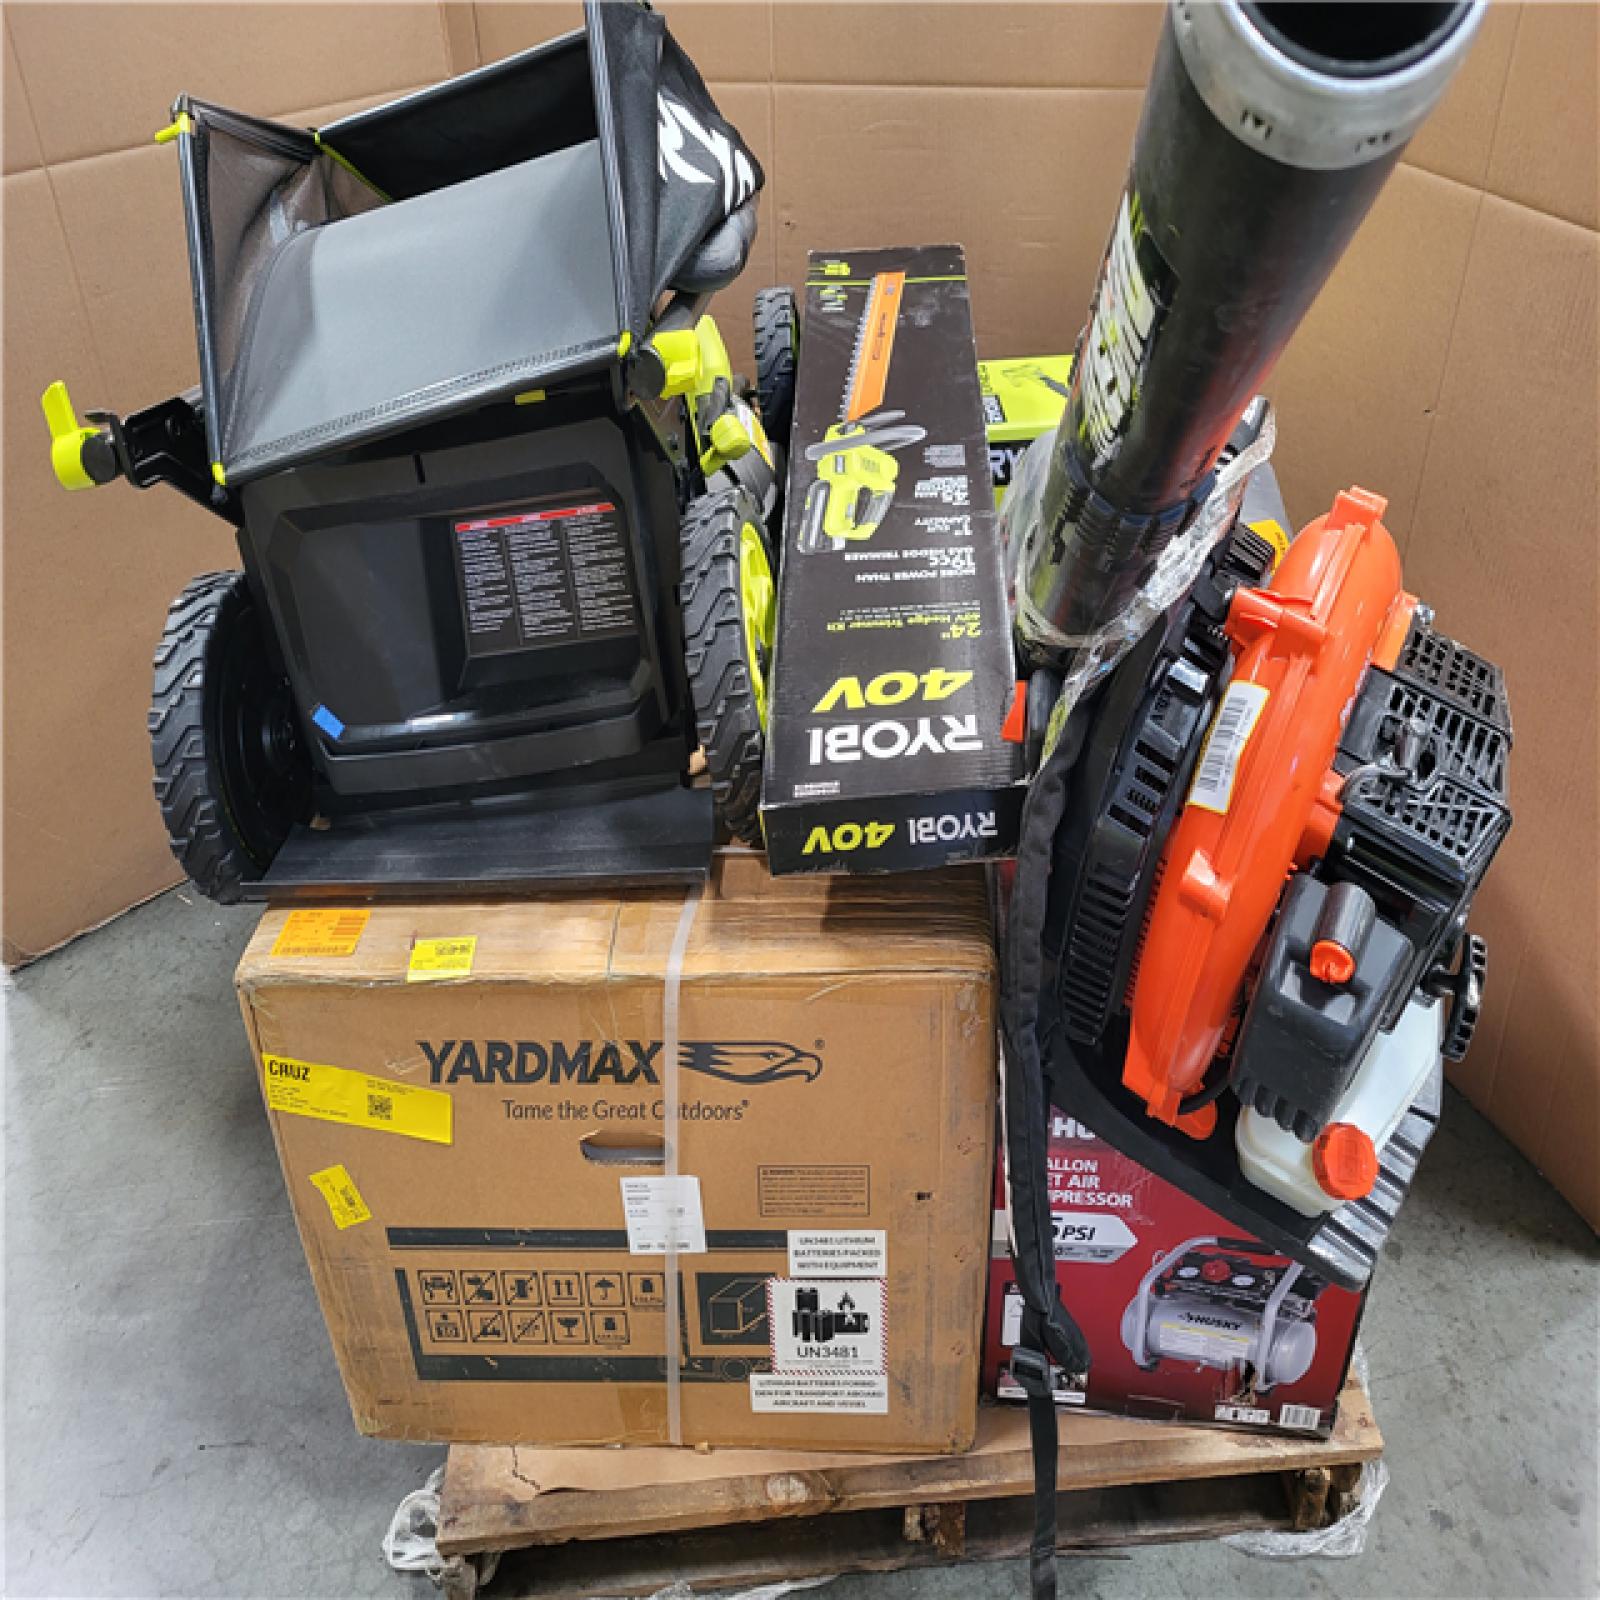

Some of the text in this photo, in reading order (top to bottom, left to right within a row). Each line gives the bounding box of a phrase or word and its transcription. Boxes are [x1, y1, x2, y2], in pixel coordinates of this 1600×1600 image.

[854, 573, 891, 583] THAN
[893, 569, 938, 580] POWER
[811, 667, 974, 713] 40V
[805, 714, 983, 766] RYOBI
[801, 811, 998, 855] RYOBI 40V
[416, 1039, 665, 1085] YARDMAX
[269, 1059, 311, 1082] CRUZ
[501, 1100, 553, 1120] Tame
[556, 1100, 589, 1120] the
[594, 1100, 647, 1120] Great
[1046, 1157, 1099, 1173] ALLON
[1067, 1174, 1101, 1190] AIR
[1061, 1224, 1096, 1241] PSI
[793, 1249, 882, 1258] BATTERIES PACKED
[824, 1262, 879, 1270] EQUIPMENT
[796, 1345, 859, 1359] UN3481
[794, 1389, 845, 1398] TRANSPORT
